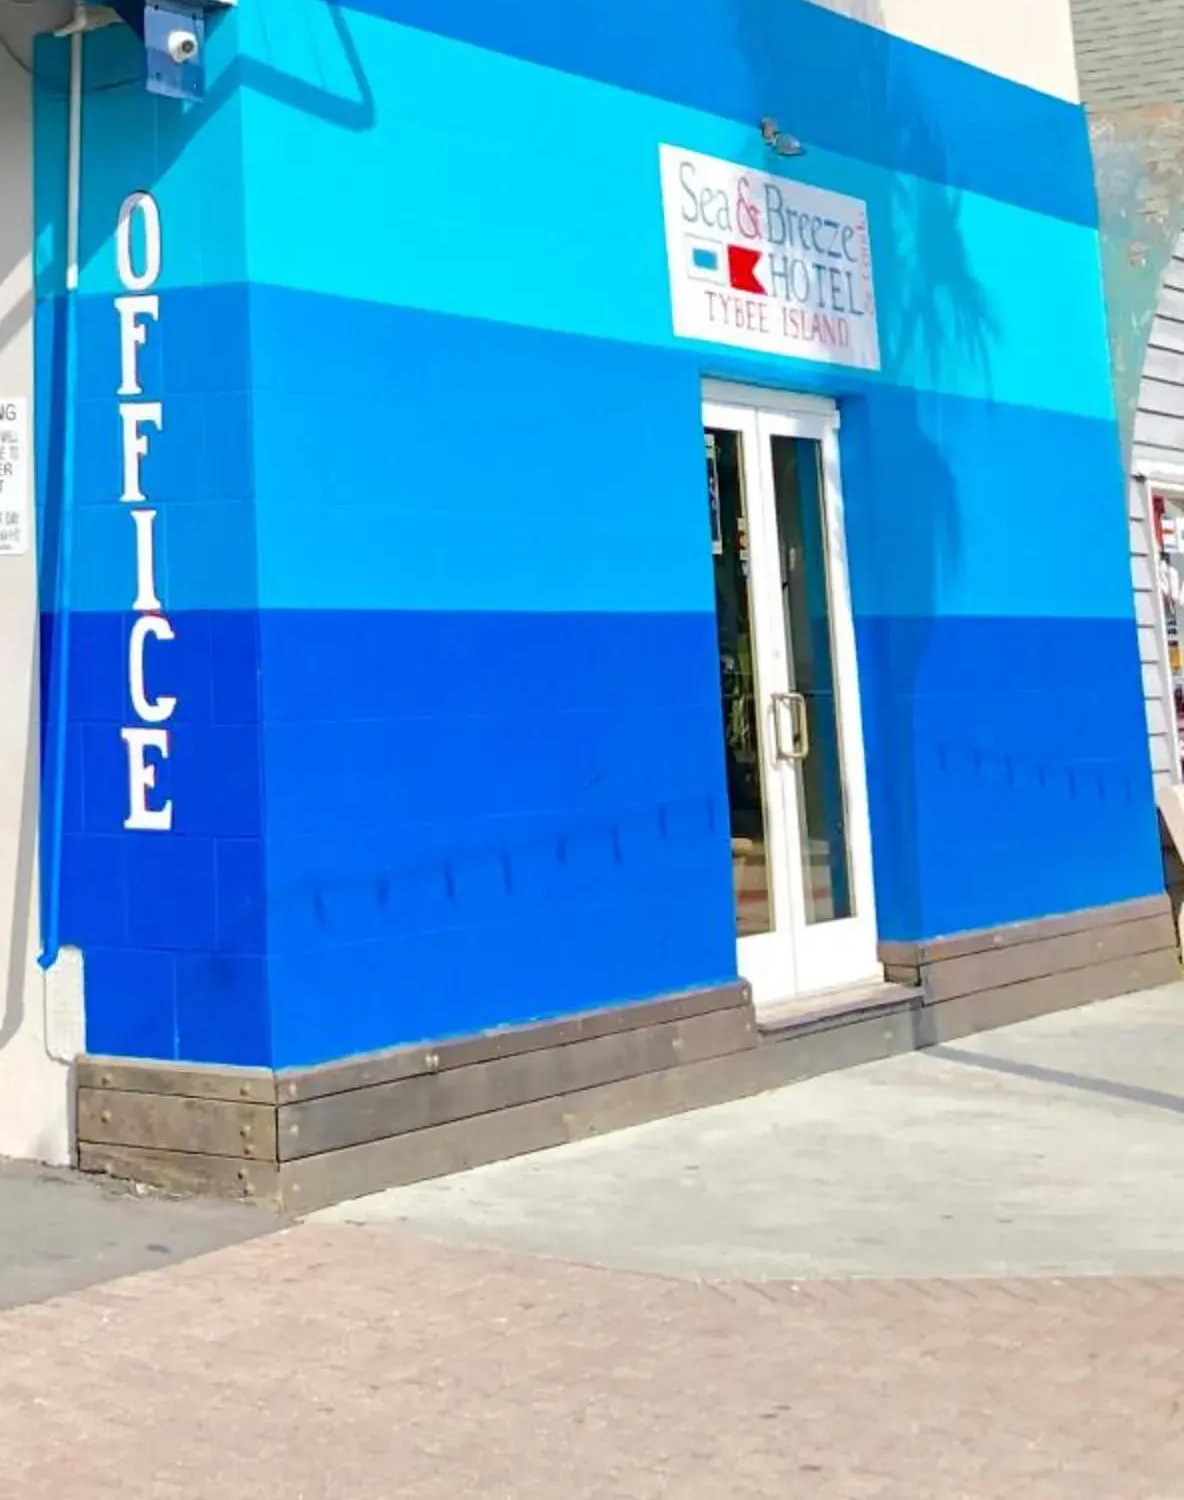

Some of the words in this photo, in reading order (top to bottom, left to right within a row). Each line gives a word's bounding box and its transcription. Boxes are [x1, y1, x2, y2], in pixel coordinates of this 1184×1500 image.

[679, 161, 733, 232] Sea
[736, 176, 763, 240] &
[763, 183, 858, 263] Breeze
[704, 291, 770, 334] TYBEE
[782, 306, 850, 348] ISLAND
[768, 253, 864, 316] HOTEL
[114, 191, 176, 830] OFFICE
